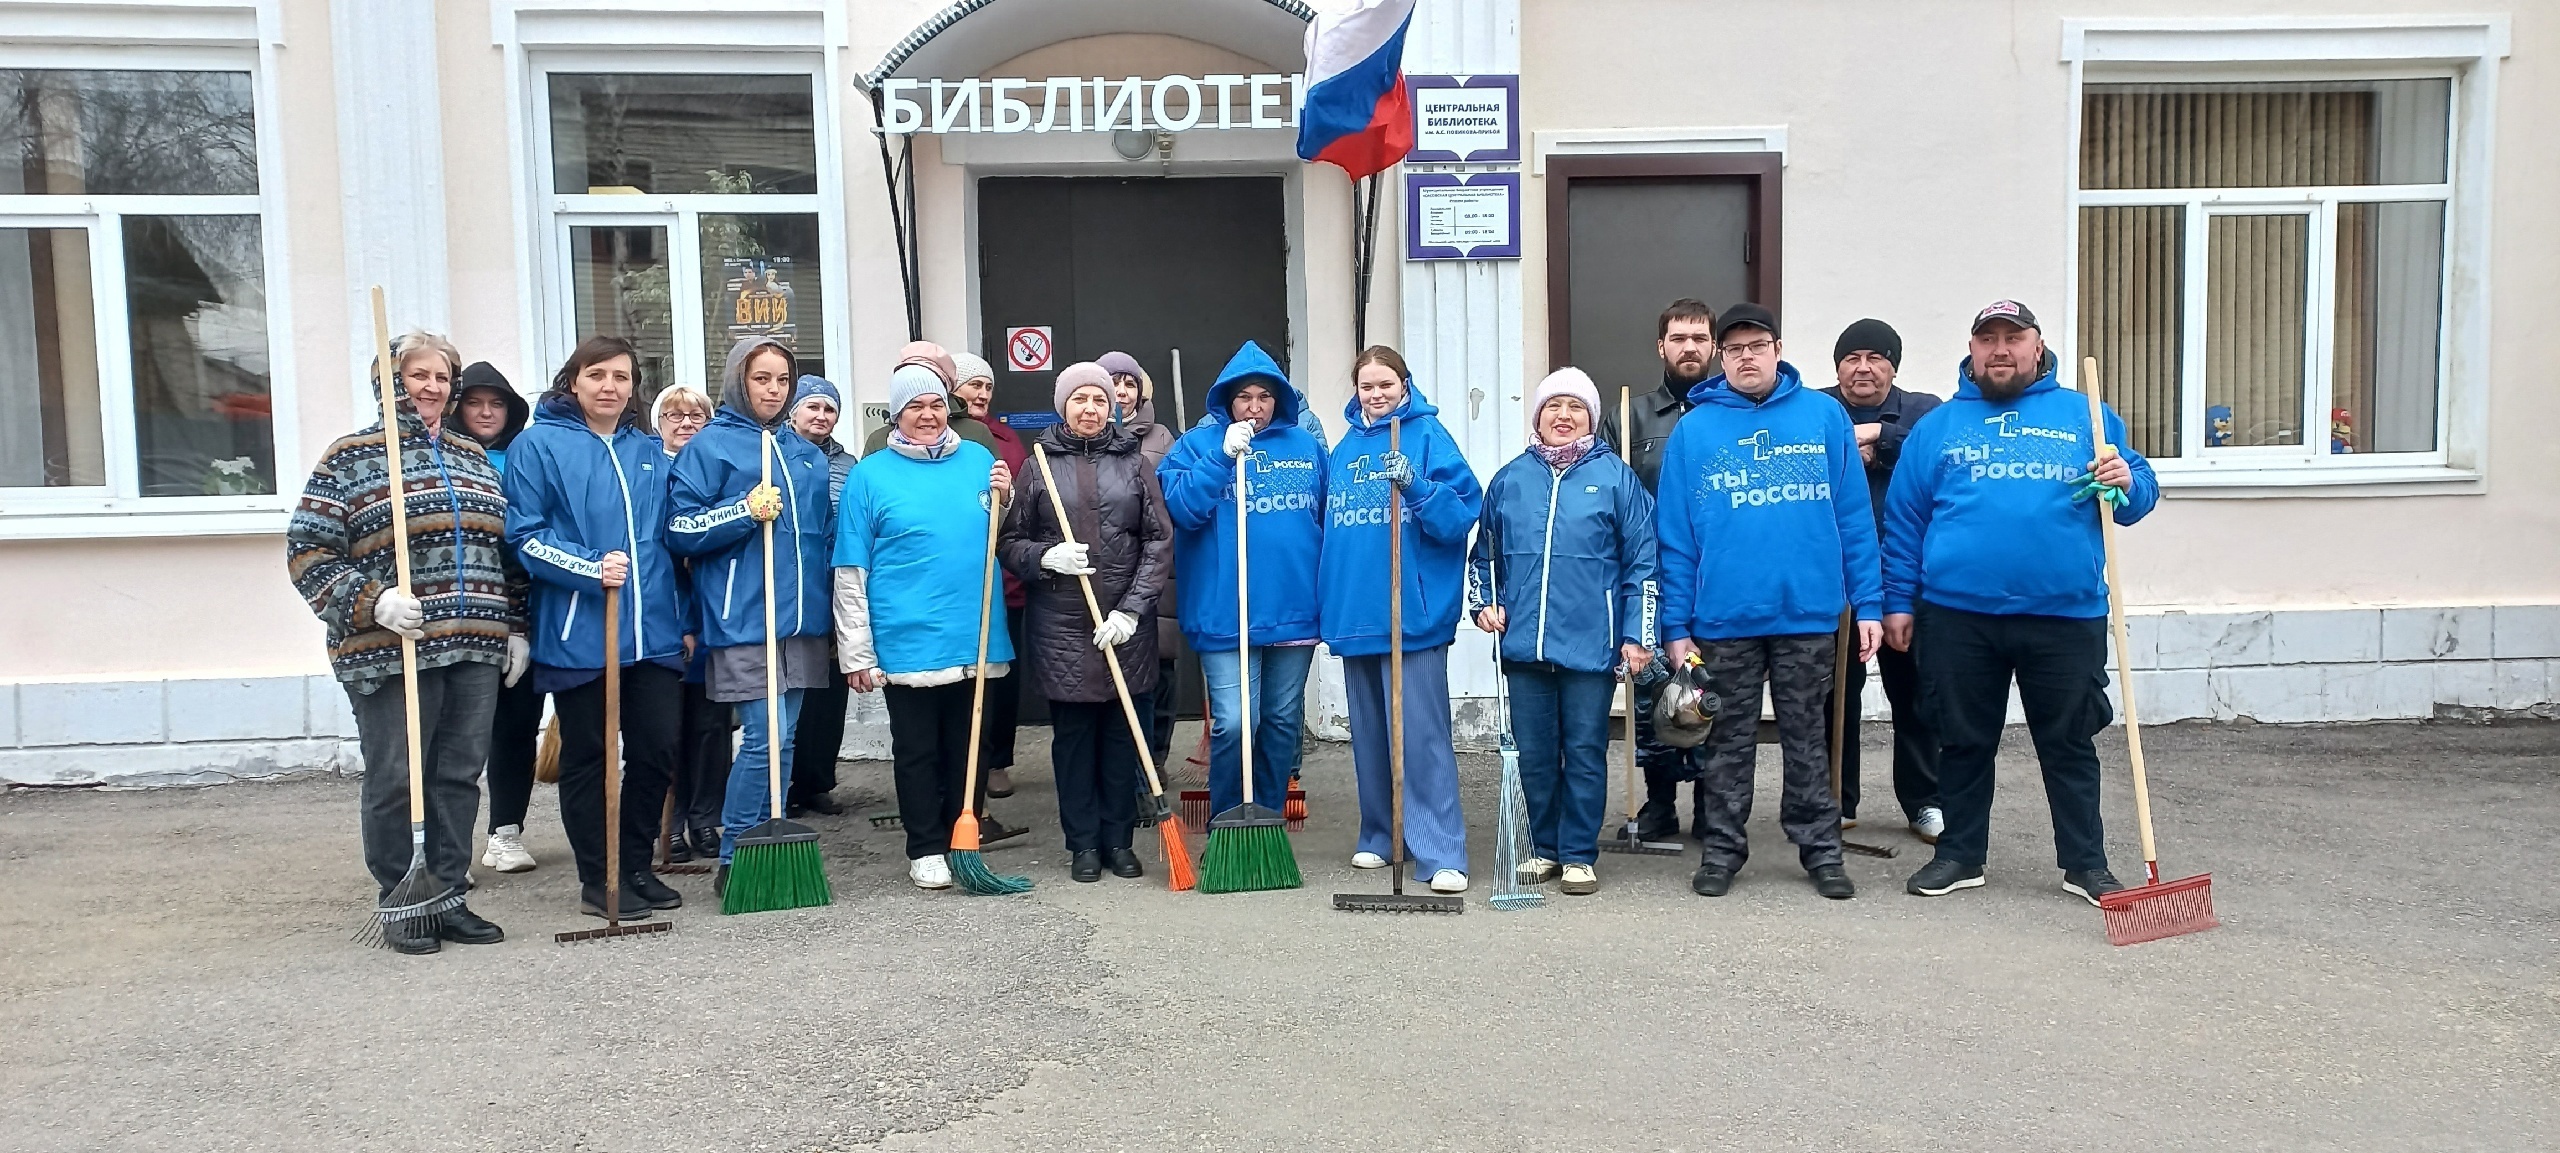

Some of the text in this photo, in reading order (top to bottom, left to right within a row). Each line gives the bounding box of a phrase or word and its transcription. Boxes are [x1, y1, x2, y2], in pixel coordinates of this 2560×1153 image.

[883, 74, 1304, 134] БИБЛИОТЕ
[1425, 103, 1500, 114] ЦЕНТРАЛЬНАЯ
[1428, 117, 1497, 127] БИБЛИОТЕКА
[1731, 482, 1831, 509] РОССИЯ
